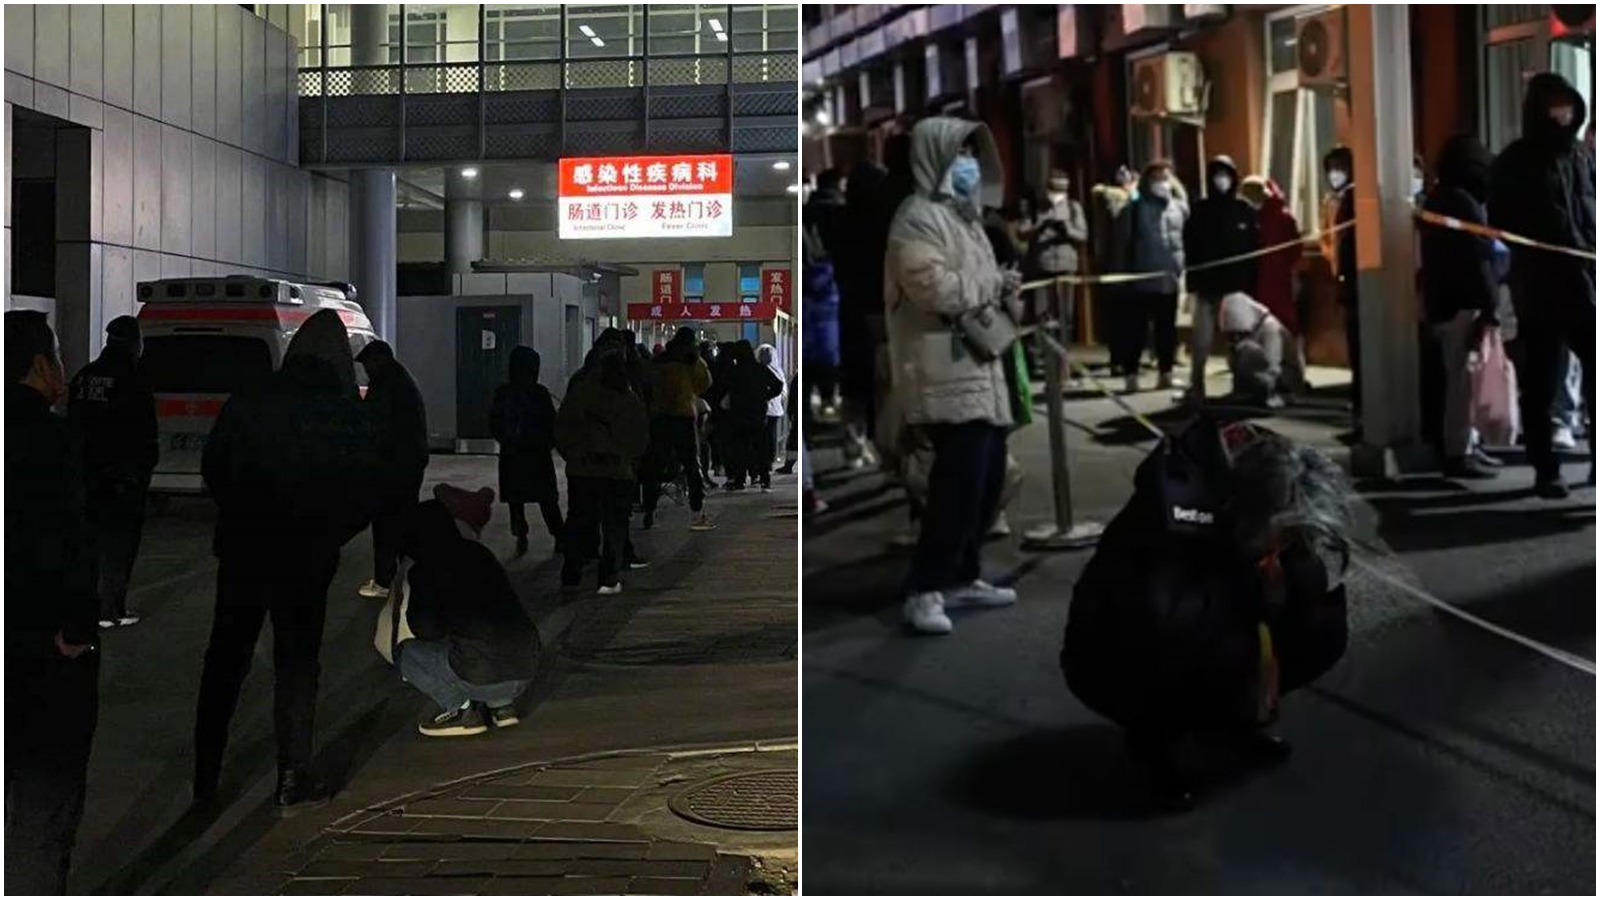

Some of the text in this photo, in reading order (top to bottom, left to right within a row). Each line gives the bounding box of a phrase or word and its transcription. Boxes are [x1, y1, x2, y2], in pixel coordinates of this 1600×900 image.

[573, 161, 718, 185] 感染性疾病科
[669, 183, 704, 191] Division
[568, 200, 723, 221] 肠道门诊 发热门诊
